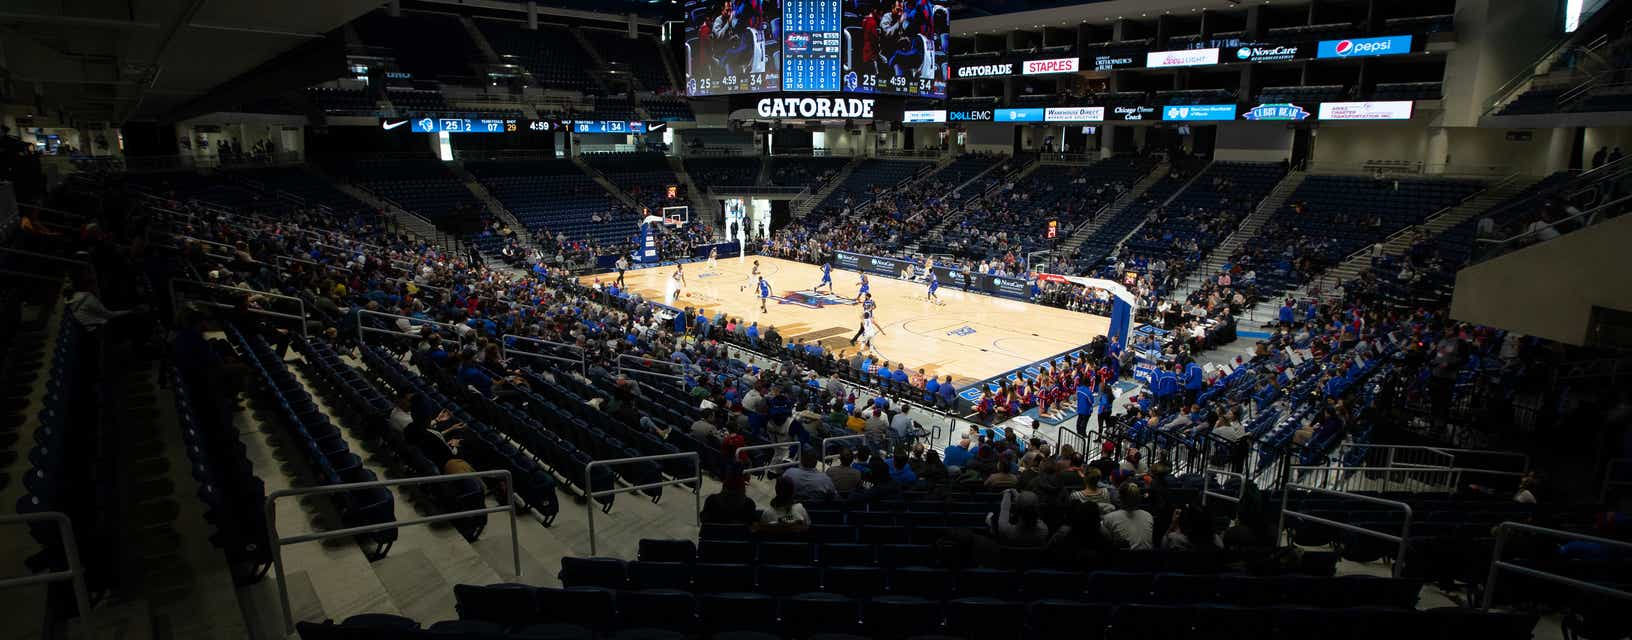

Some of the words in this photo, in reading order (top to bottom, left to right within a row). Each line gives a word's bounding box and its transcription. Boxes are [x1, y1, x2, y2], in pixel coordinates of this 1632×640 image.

[1251, 46, 1297, 57] NovaCare
[1354, 40, 1390, 56] pepsi
[958, 64, 1013, 77] GATORADE
[1029, 60, 1072, 72] STAPLES
[700, 78, 711, 88] 25
[722, 76, 737, 85] 4:59
[750, 74, 762, 86] 34
[863, 75, 876, 86] 25
[890, 76, 906, 86] 4:59
[920, 79, 931, 90] 34
[758, 98, 874, 118] GATORADE
[446, 121, 458, 130] 25
[530, 122, 549, 130] 4:59
[612, 123, 621, 131] 34
[1002, 280, 1024, 288] NovaCare
